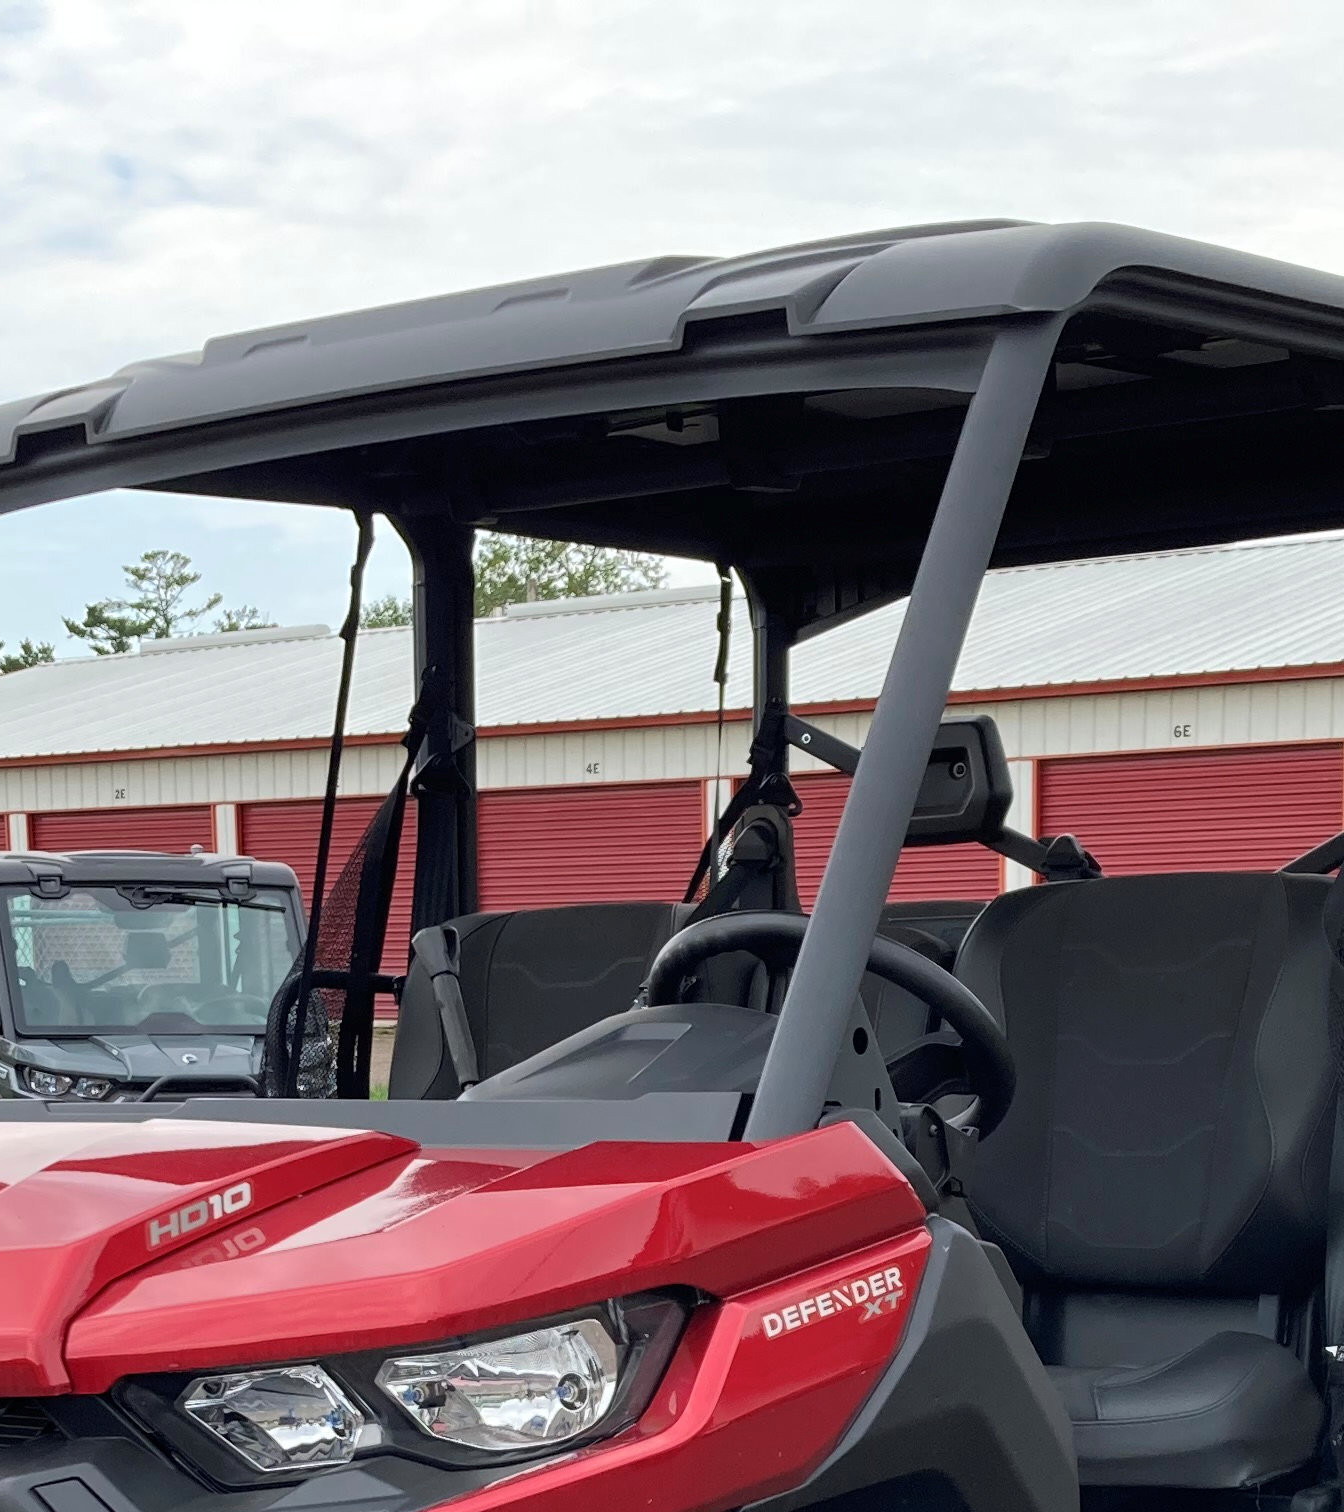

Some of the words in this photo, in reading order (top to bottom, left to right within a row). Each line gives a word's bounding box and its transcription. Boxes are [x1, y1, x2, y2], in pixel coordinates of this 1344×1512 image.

[1173, 725, 1192, 738] 6E
[586, 762, 600, 774] 4E
[115, 789, 126, 800] 2E
[149, 1181, 252, 1248] HD10
[762, 1267, 904, 1338] DEFENDER
[863, 1289, 904, 1321] XT
